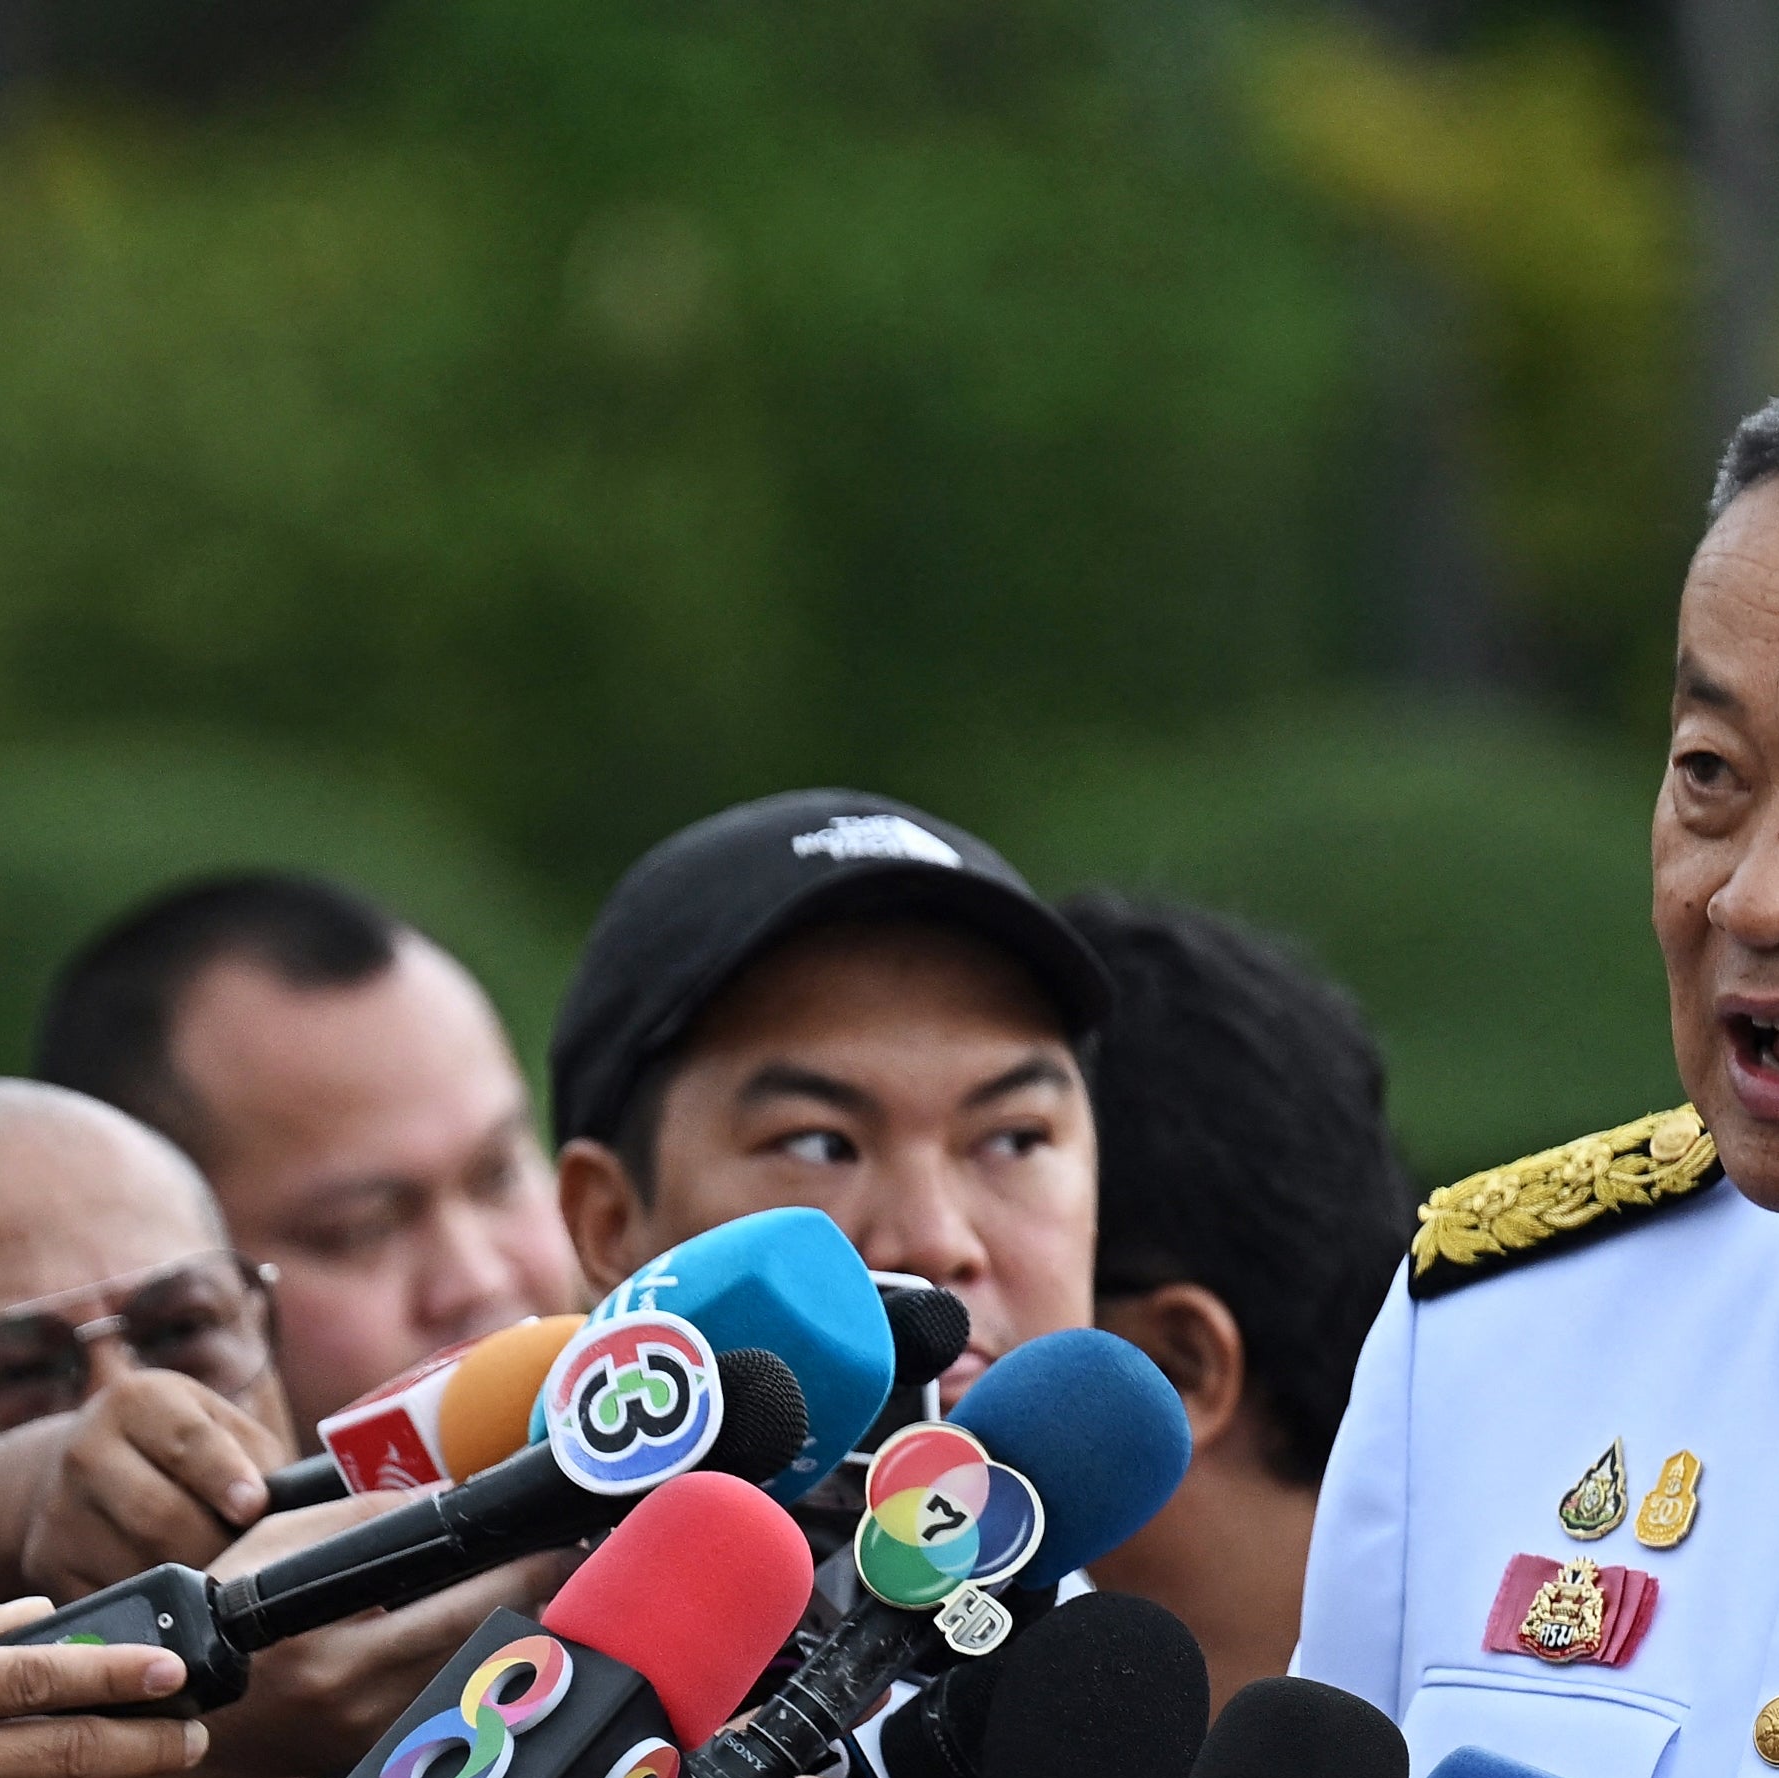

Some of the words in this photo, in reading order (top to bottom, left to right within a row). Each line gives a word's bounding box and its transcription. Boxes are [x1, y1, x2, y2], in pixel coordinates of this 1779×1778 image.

[576, 1344, 692, 1456] 3
[921, 1493, 967, 1543] 7
[945, 1588, 1006, 1650] HD
[724, 1737, 768, 1772] SONY
